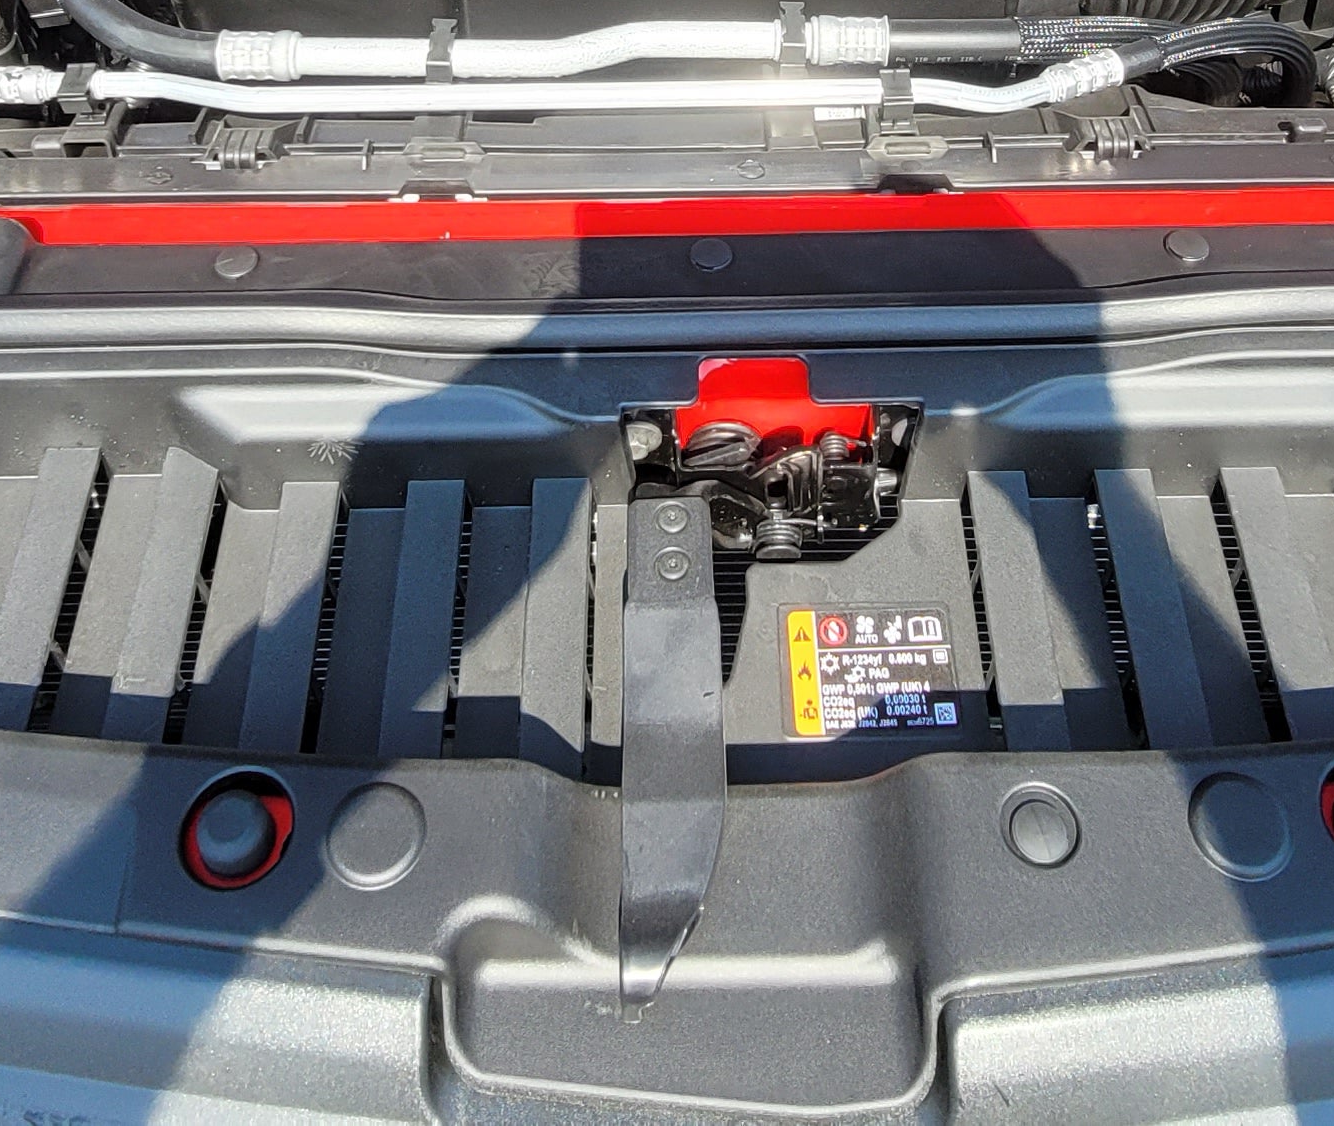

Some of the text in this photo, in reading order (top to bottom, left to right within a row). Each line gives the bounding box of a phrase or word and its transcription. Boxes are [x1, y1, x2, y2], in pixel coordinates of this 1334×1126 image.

[855, 634, 878, 644] AUTO
[842, 653, 882, 667] R-1234yf
[914, 652, 927, 666] kg
[869, 667, 890, 679] PAG
[822, 684, 845, 695] GWP
[876, 682, 900, 694] GWP
[901, 681, 923, 694] (UK)
[924, 681, 930, 692] 4
[823, 695, 855, 708] CO2eq
[922, 694, 926, 703] t
[824, 705, 928, 720] CO2eq (UK) 0.00240 t
